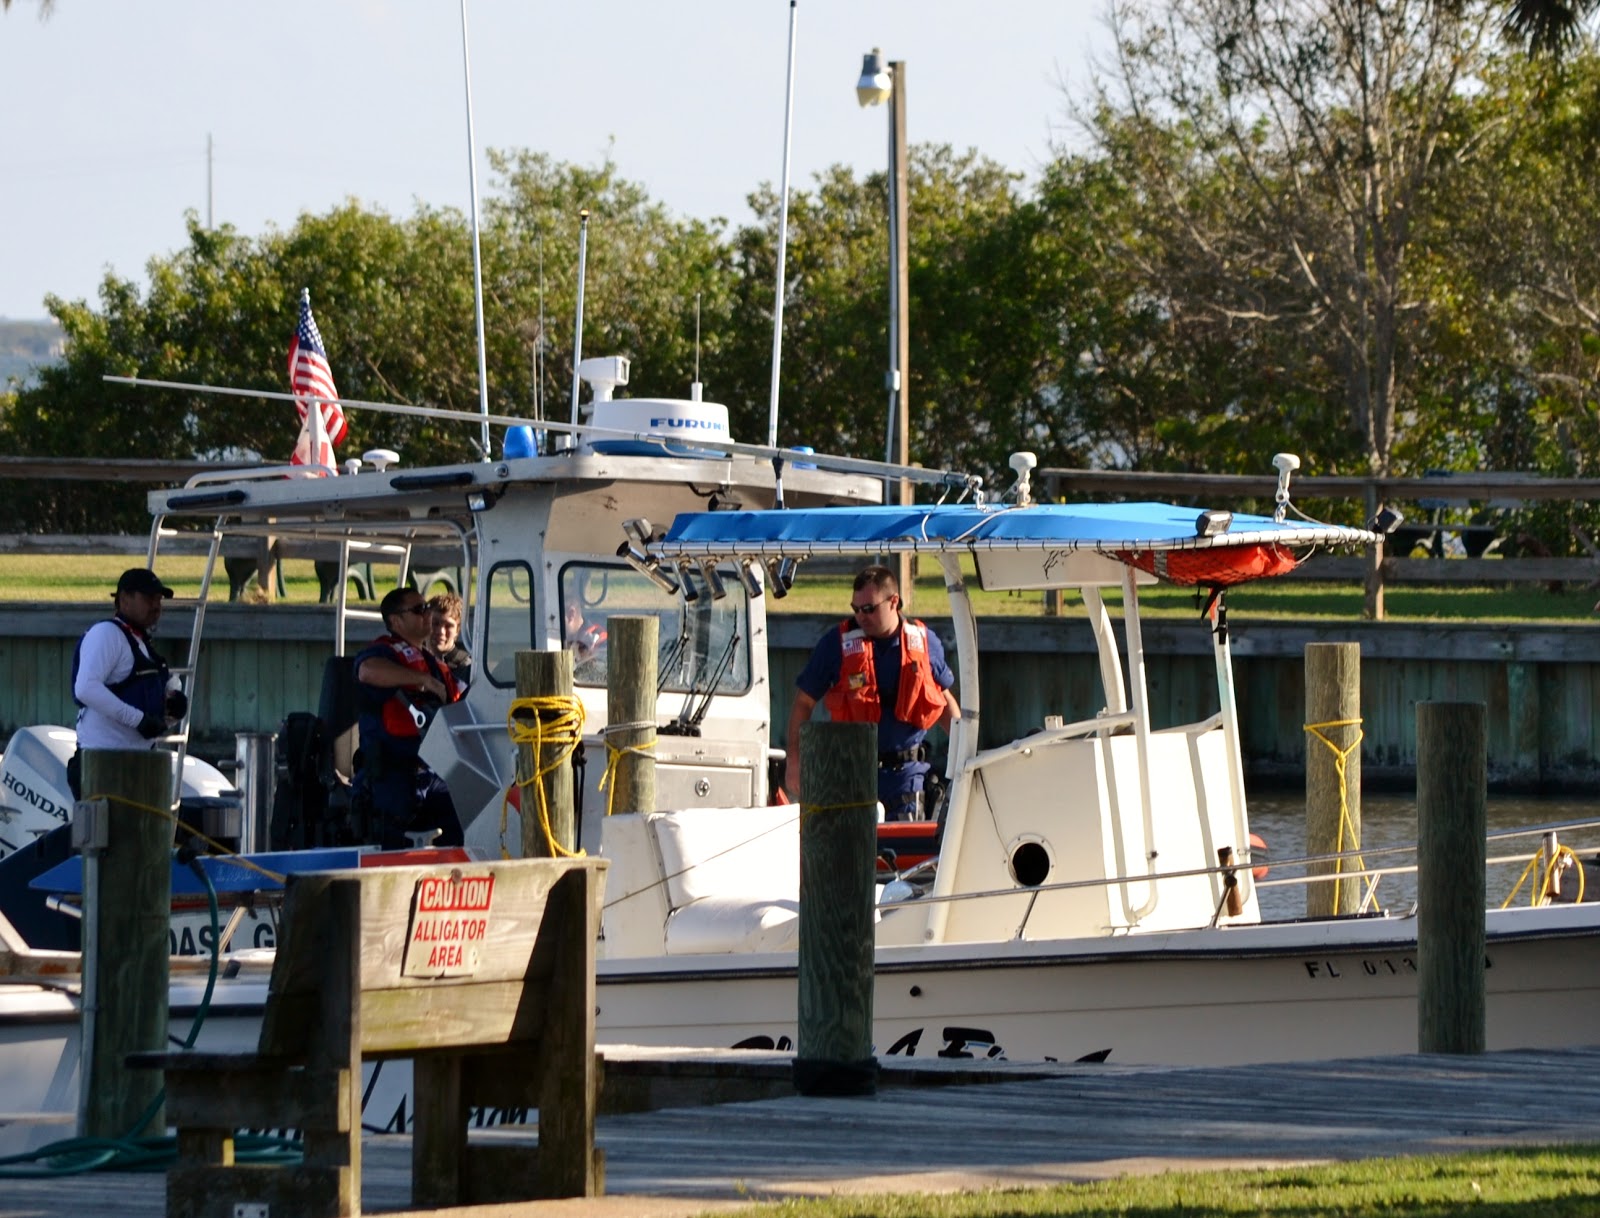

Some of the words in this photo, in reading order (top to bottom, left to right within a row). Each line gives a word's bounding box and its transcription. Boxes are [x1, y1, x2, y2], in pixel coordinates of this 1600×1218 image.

[3, 771, 69, 823] HONDA
[422, 879, 490, 909] CAUTION
[414, 919, 486, 942] ALLIGATOR
[427, 945, 463, 968] AREA
[1304, 960, 1341, 978] FL
